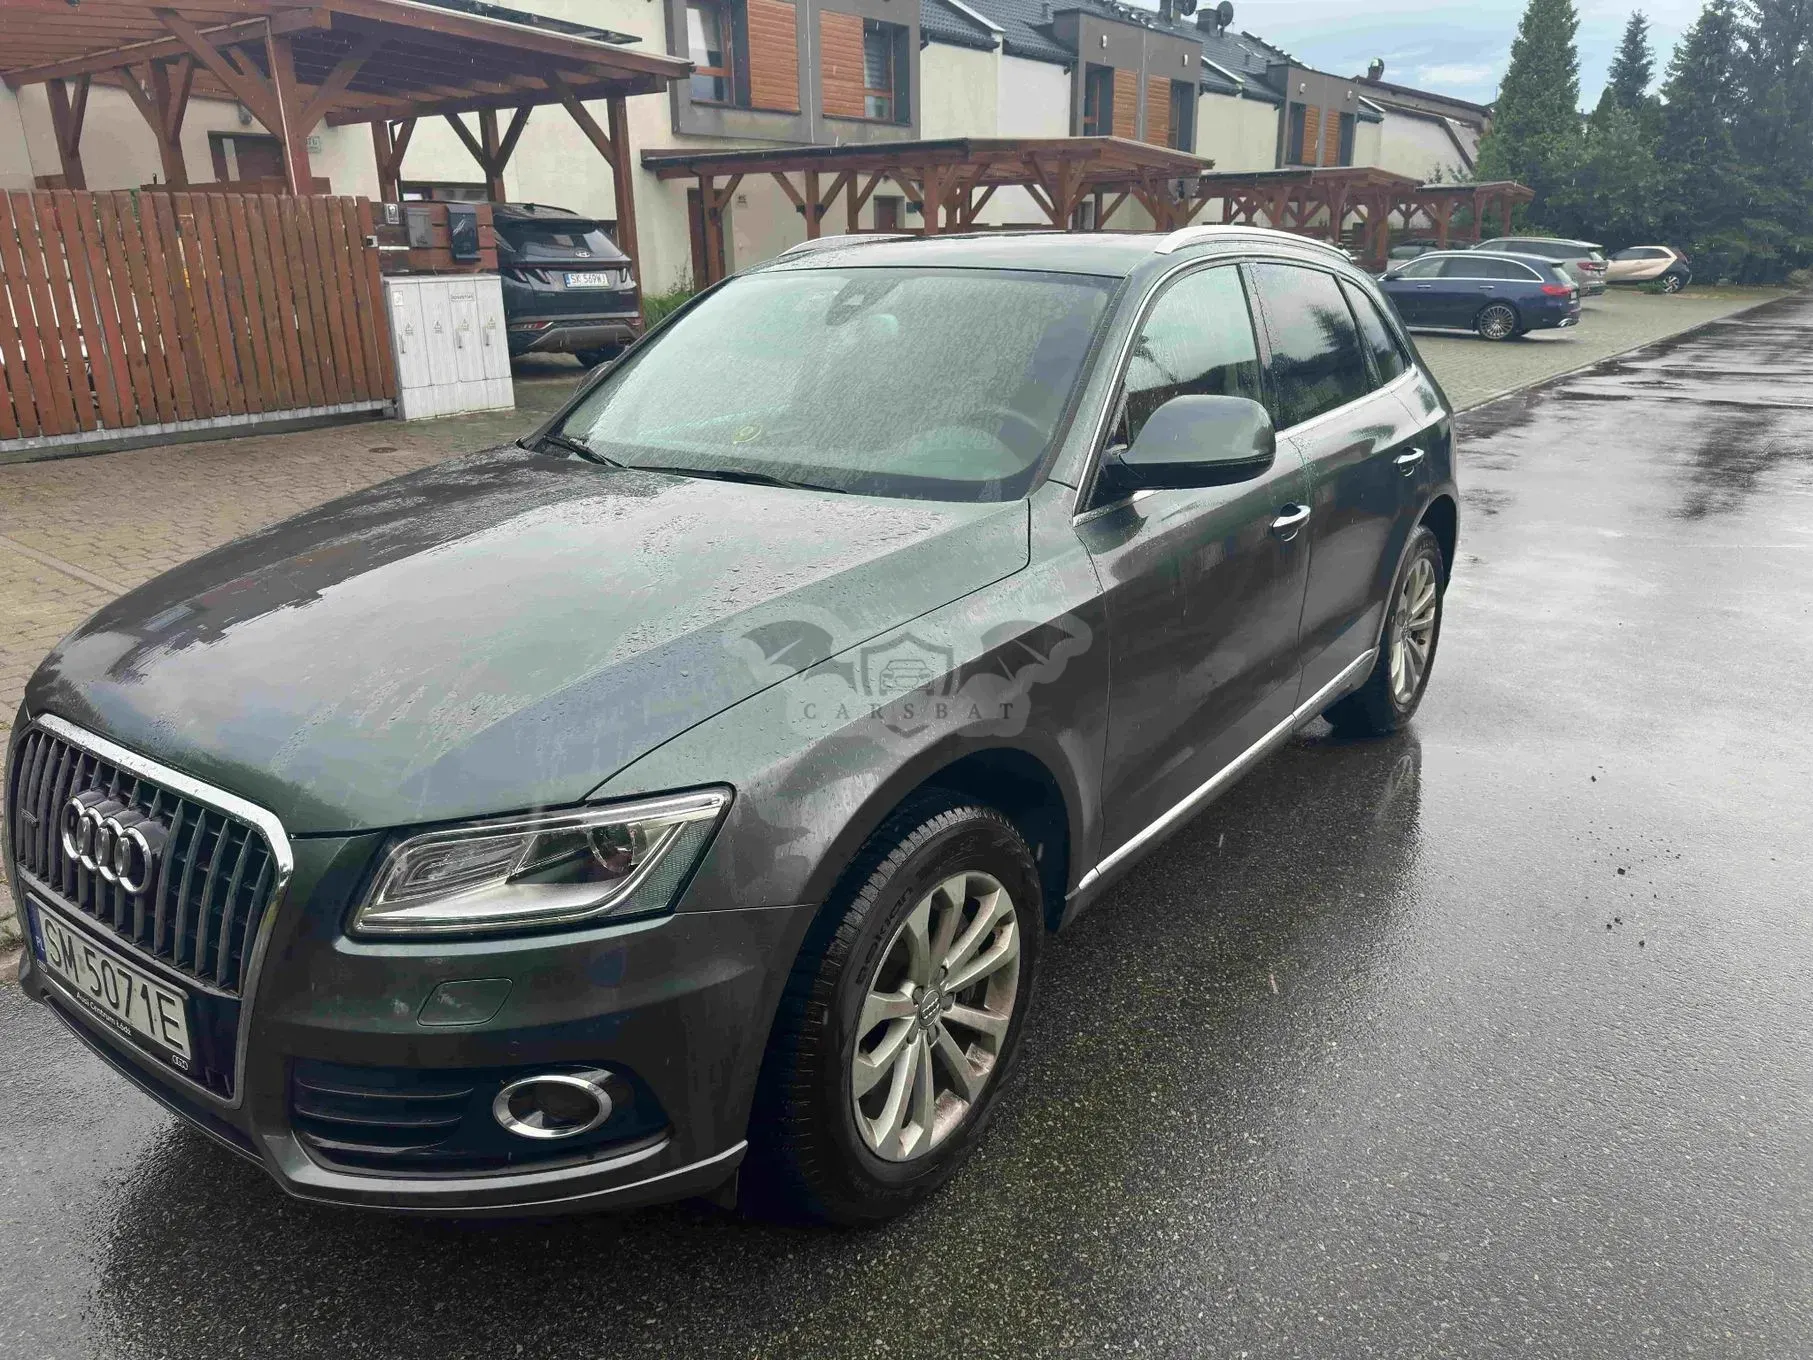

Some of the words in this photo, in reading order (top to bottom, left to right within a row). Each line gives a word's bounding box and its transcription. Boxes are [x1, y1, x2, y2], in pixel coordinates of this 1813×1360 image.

[570, 273, 581, 284] SK
[35, 935, 45, 951] PL
[45, 918, 79, 983] SM
[83, 945, 183, 1050] 5071E
